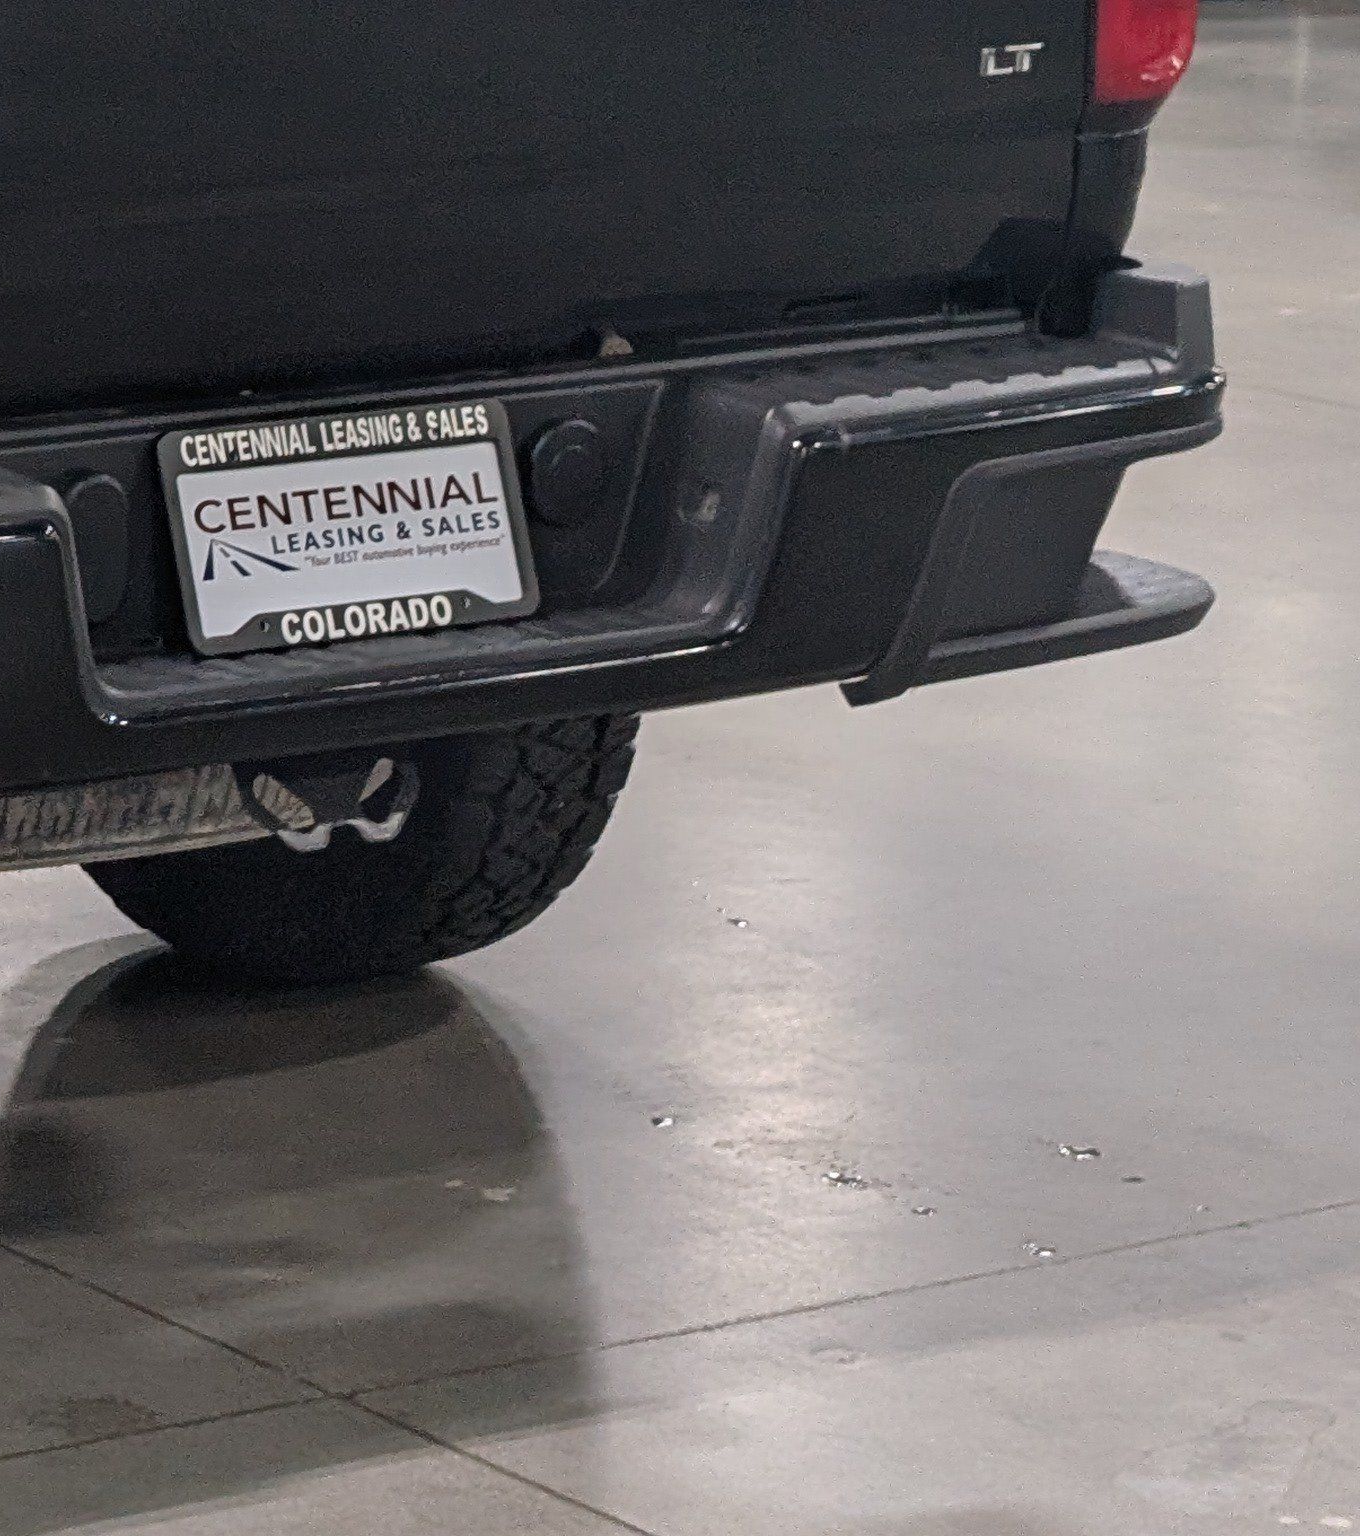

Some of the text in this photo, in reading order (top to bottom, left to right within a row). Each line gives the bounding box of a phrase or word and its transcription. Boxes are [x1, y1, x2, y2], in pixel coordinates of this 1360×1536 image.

[980, 42, 1045, 77] LT
[180, 404, 490, 467] CENTENNIAL LEASING & SALES
[193, 471, 499, 534] CENTENNIAL
[270, 510, 501, 555] LEASING & SALES
[333, 549, 359, 564] BEST
[281, 594, 453, 645] COLORADO
